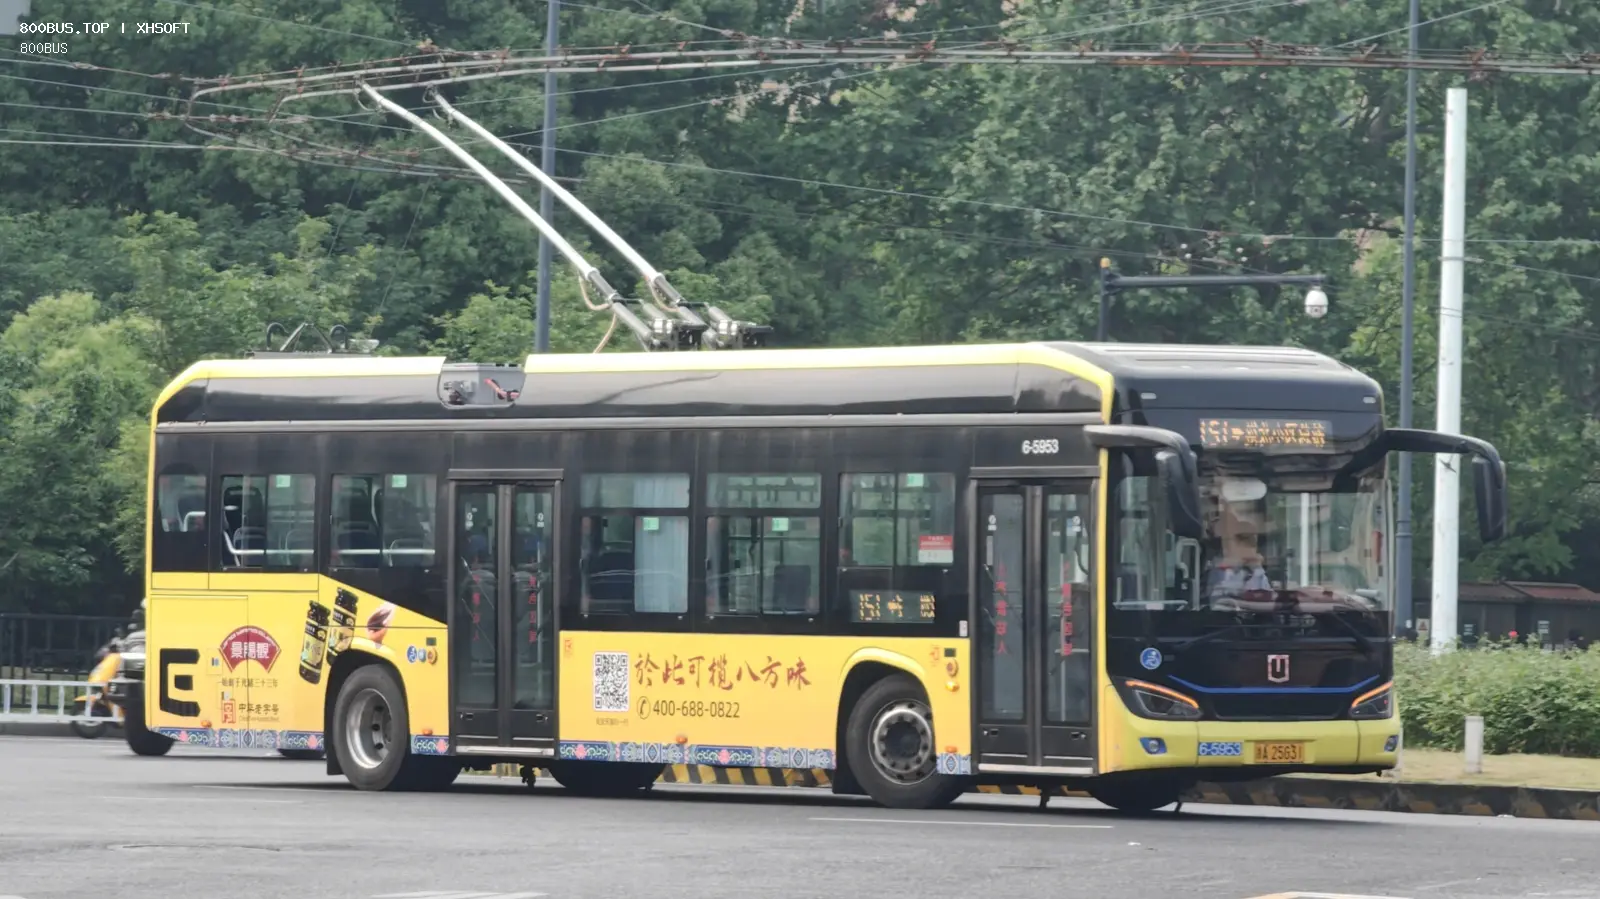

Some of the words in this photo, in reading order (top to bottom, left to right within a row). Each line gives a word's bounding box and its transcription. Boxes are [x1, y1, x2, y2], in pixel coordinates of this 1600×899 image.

[1199, 420, 1229, 446] 151
[1021, 438, 1060, 455] 6-5953
[652, 700, 741, 719] 400-688-0822
[1199, 742, 1242, 756] 6-5953
